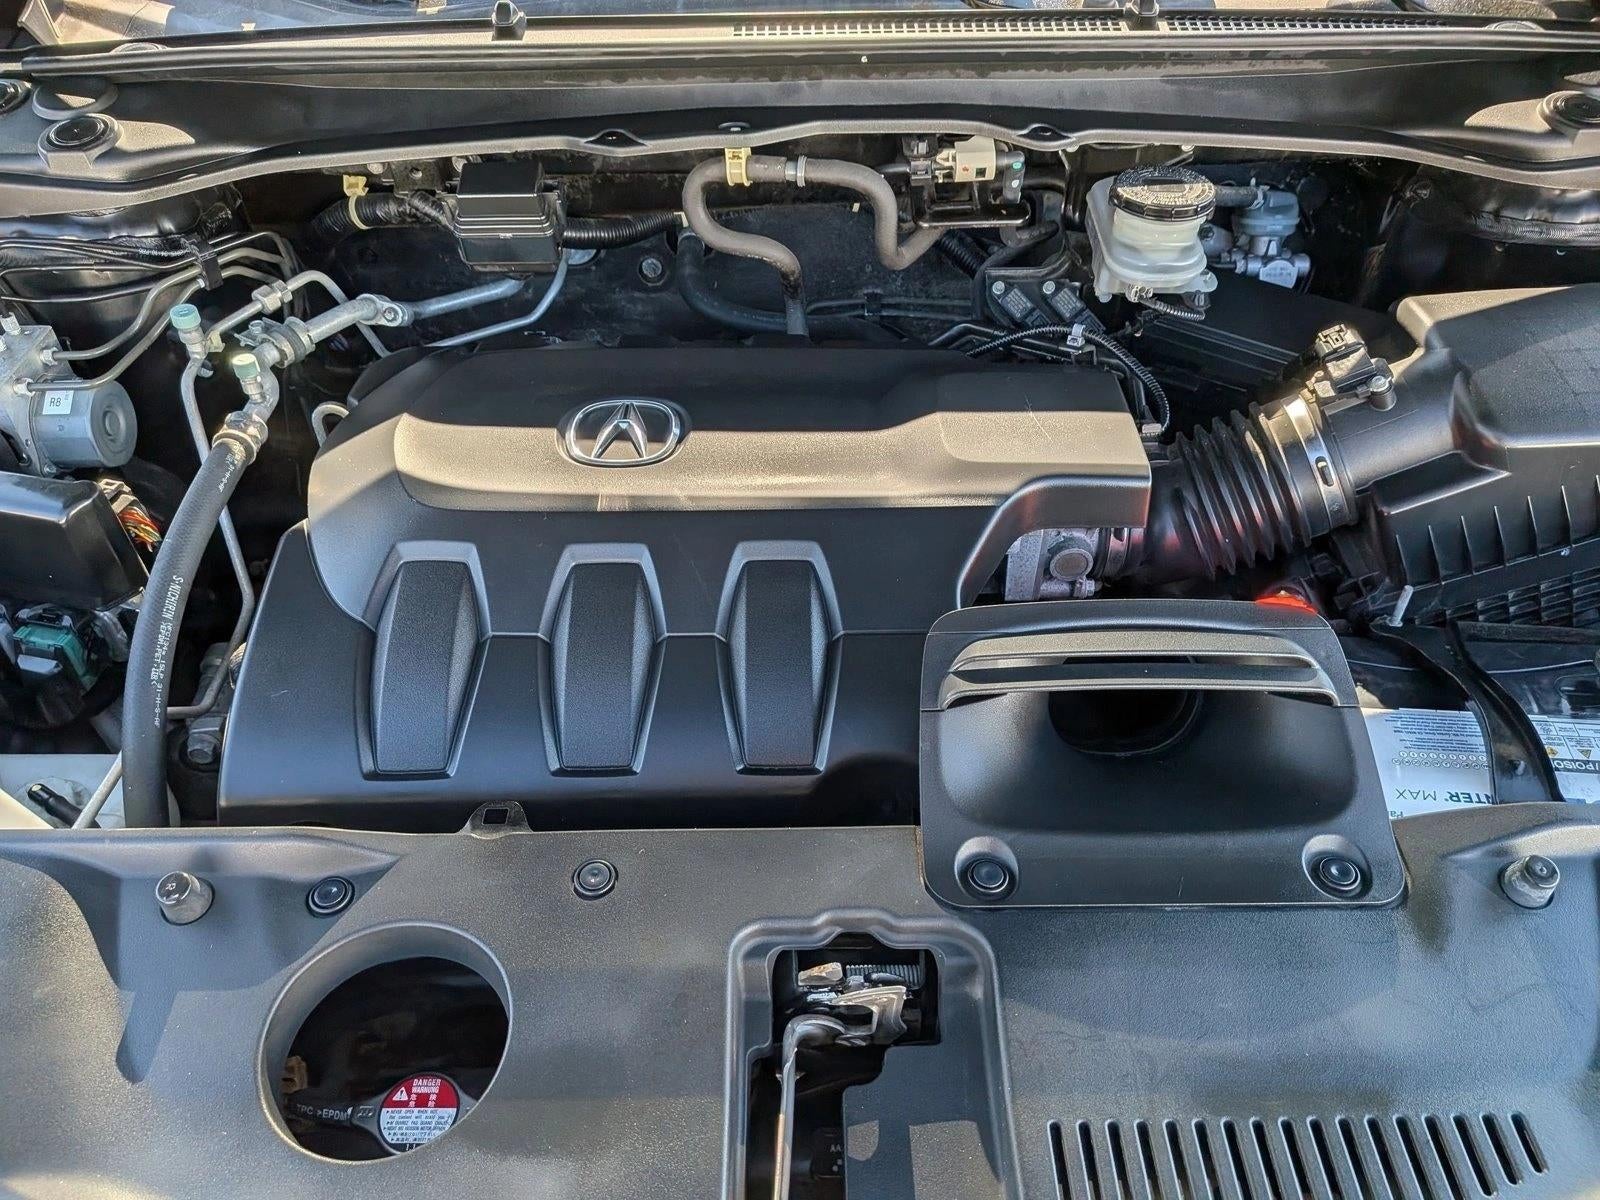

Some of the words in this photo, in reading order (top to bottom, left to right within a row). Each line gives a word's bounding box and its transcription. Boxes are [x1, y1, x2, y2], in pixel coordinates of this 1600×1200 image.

[49, 397, 62, 407] R8
[1395, 788, 1437, 801] MAX
[413, 1078, 441, 1086] DANGER
[411, 1086, 440, 1094] WARNUNG
